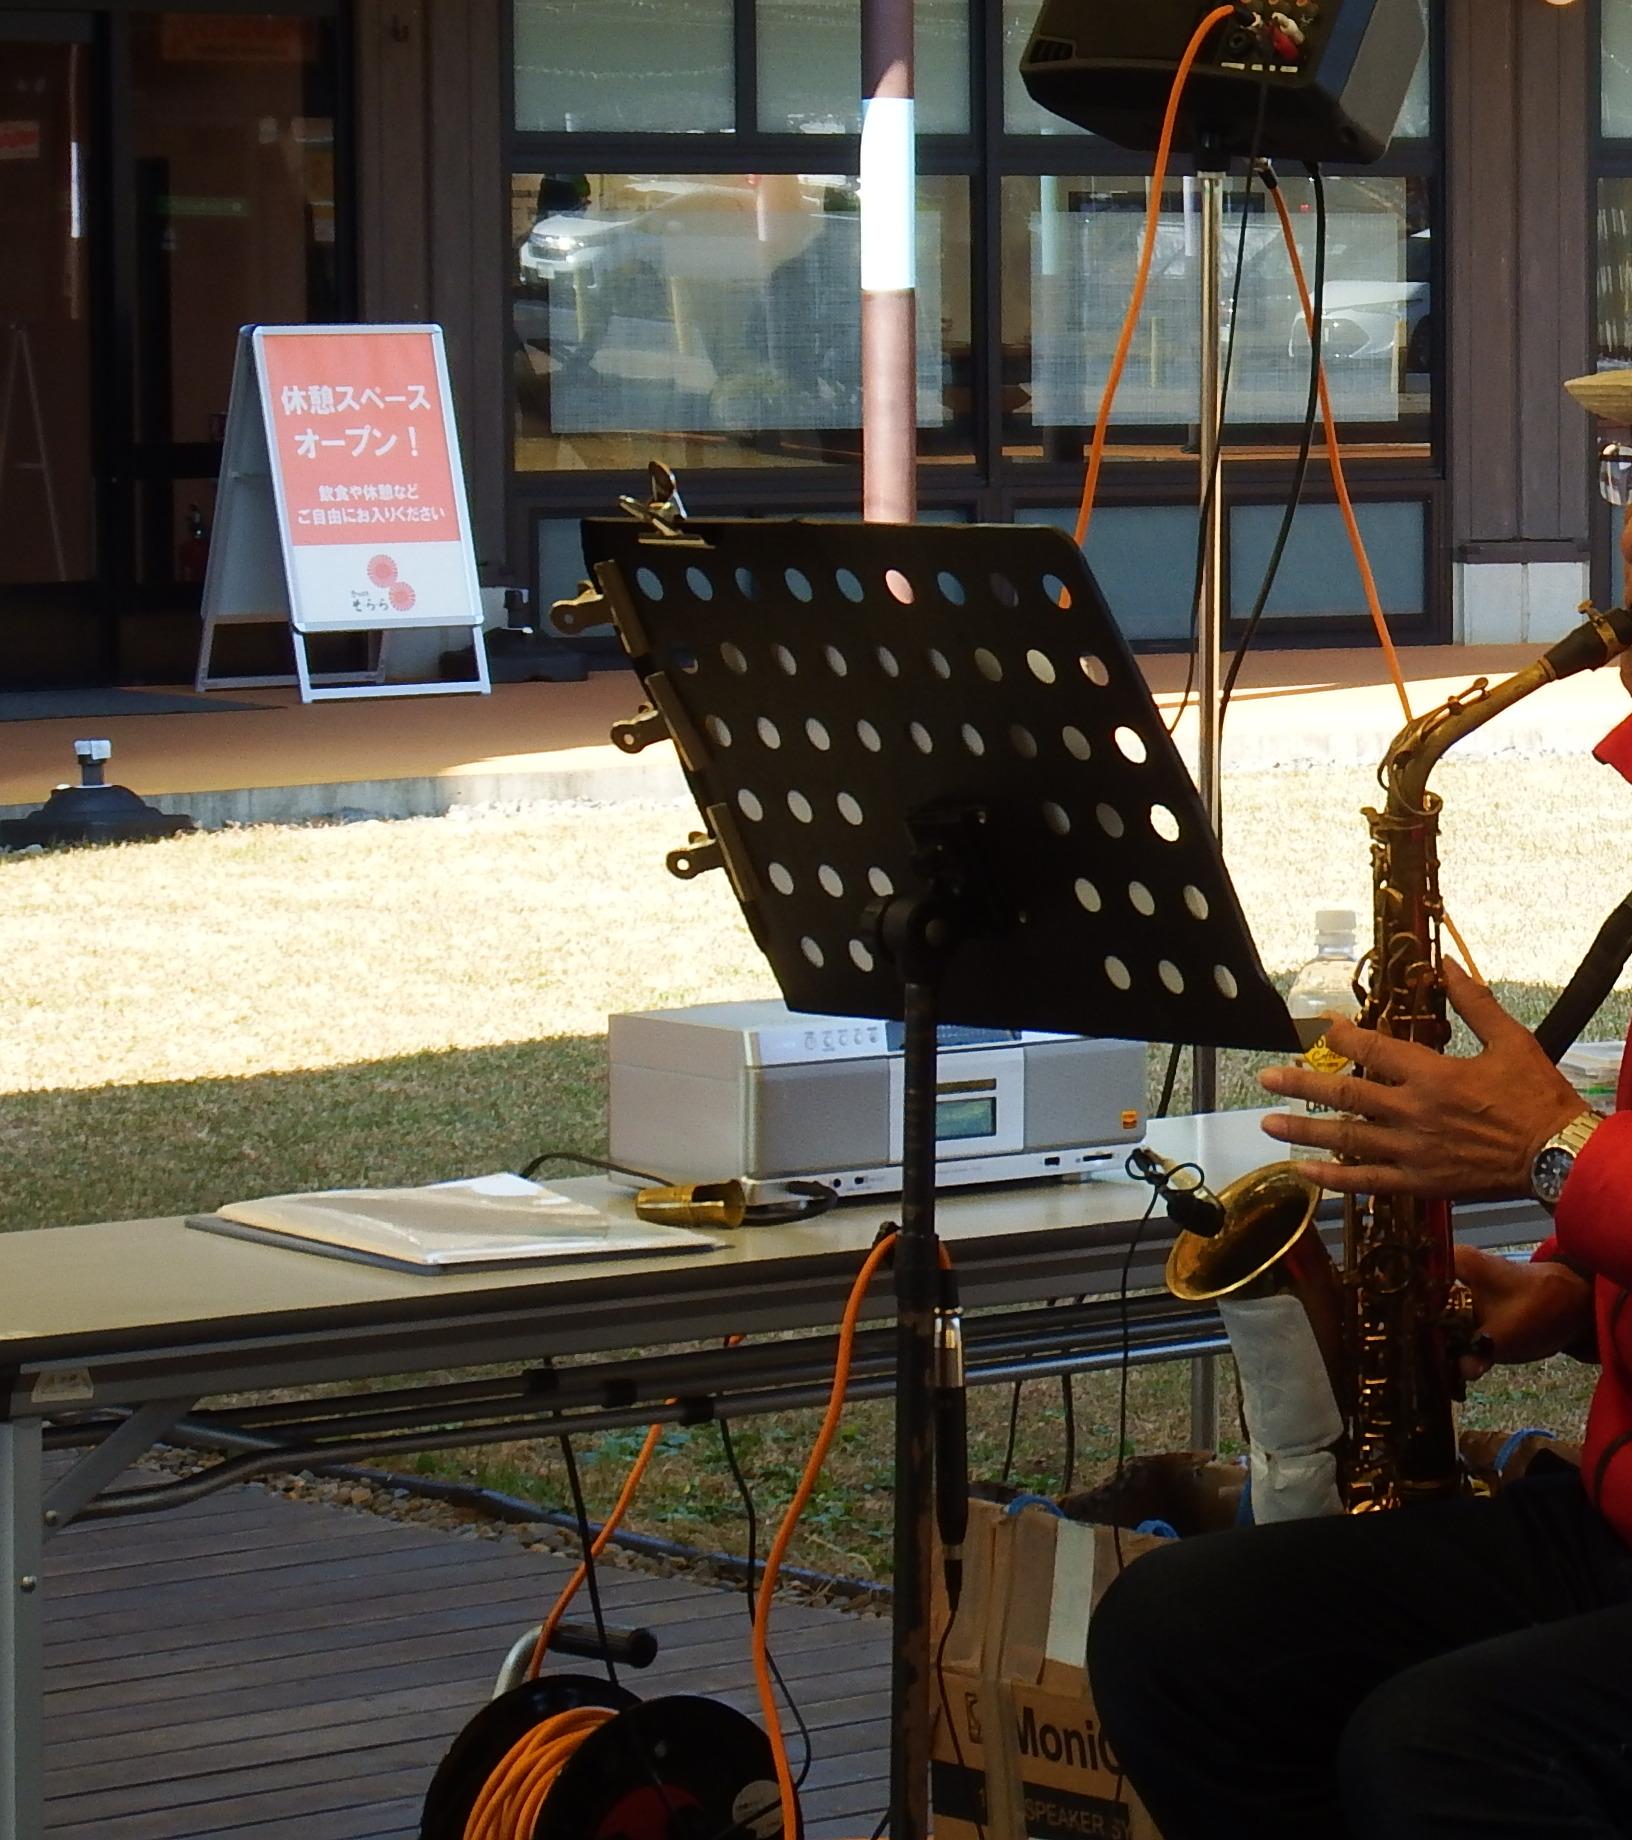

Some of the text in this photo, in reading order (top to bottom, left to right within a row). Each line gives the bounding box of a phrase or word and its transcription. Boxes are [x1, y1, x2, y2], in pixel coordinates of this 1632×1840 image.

[281, 385, 431, 415] 休憩スペース
[294, 425, 418, 459] オープン！
[318, 483, 419, 502] 飲食や休憩など
[297, 506, 445, 525] ご自由にお入りください
[1024, 1797, 1105, 1833] SPEAKER
